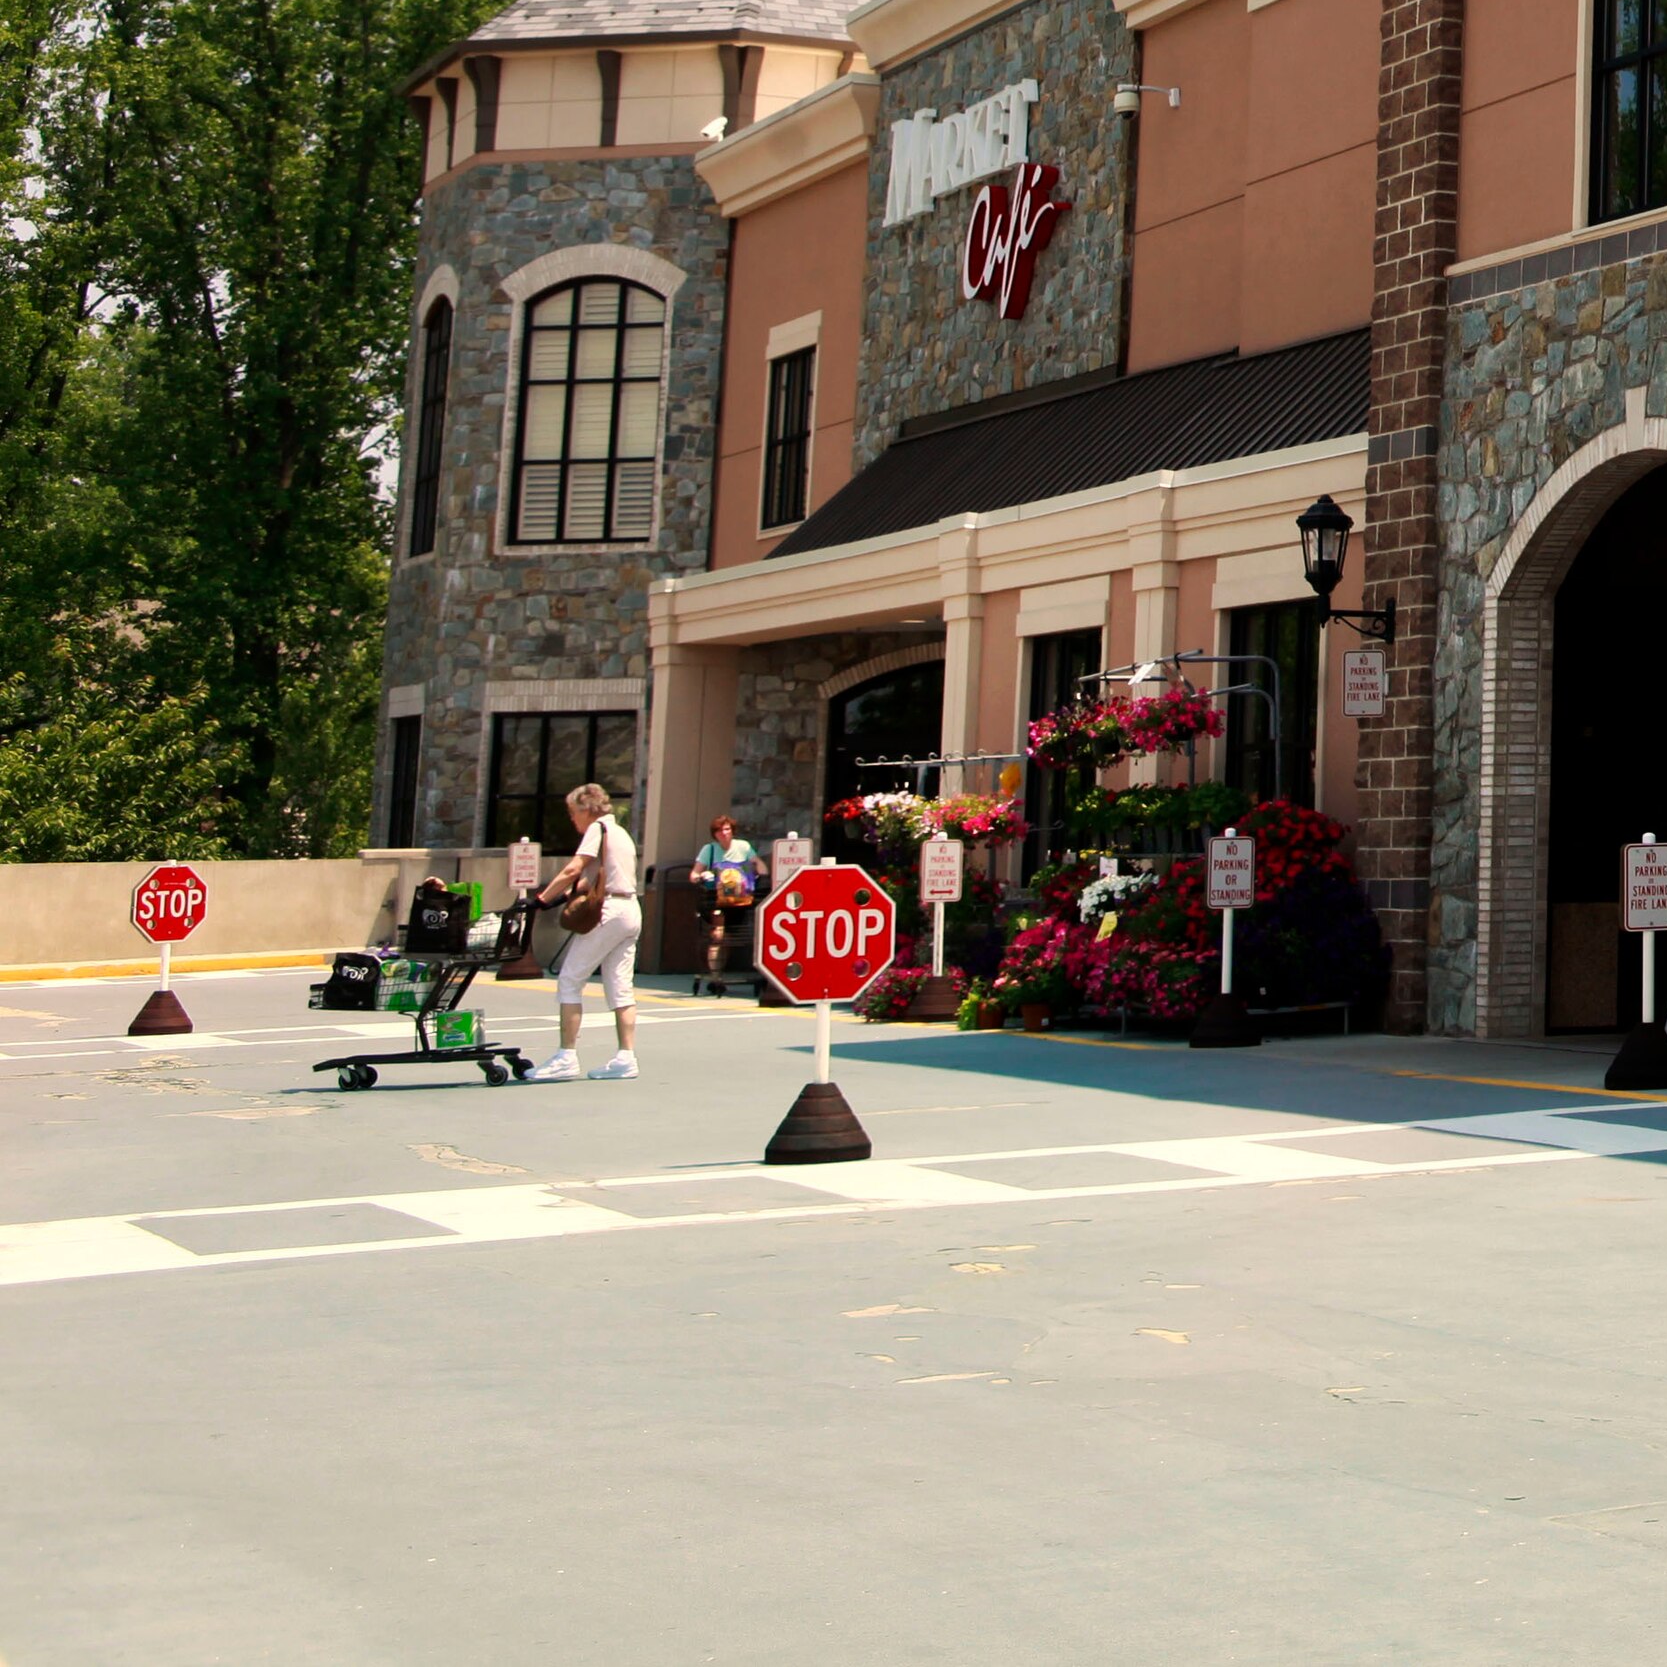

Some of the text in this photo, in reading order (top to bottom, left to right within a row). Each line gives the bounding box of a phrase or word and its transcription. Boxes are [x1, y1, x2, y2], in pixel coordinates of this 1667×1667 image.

[1350, 667, 1377, 675] PARKING
[1349, 682, 1379, 691] STANDING
[1364, 692, 1380, 701] LANE
[1226, 844, 1238, 855] NO
[1645, 852, 1657, 863] NO
[1213, 859, 1249, 870] PARKING
[1634, 865, 1667, 876] PARKING
[1225, 874, 1237, 885] OR
[1211, 890, 1251, 900] STANDING
[140, 889, 203, 919] STOP
[1631, 899, 1647, 910] FIRE
[769, 909, 885, 961] STOP
